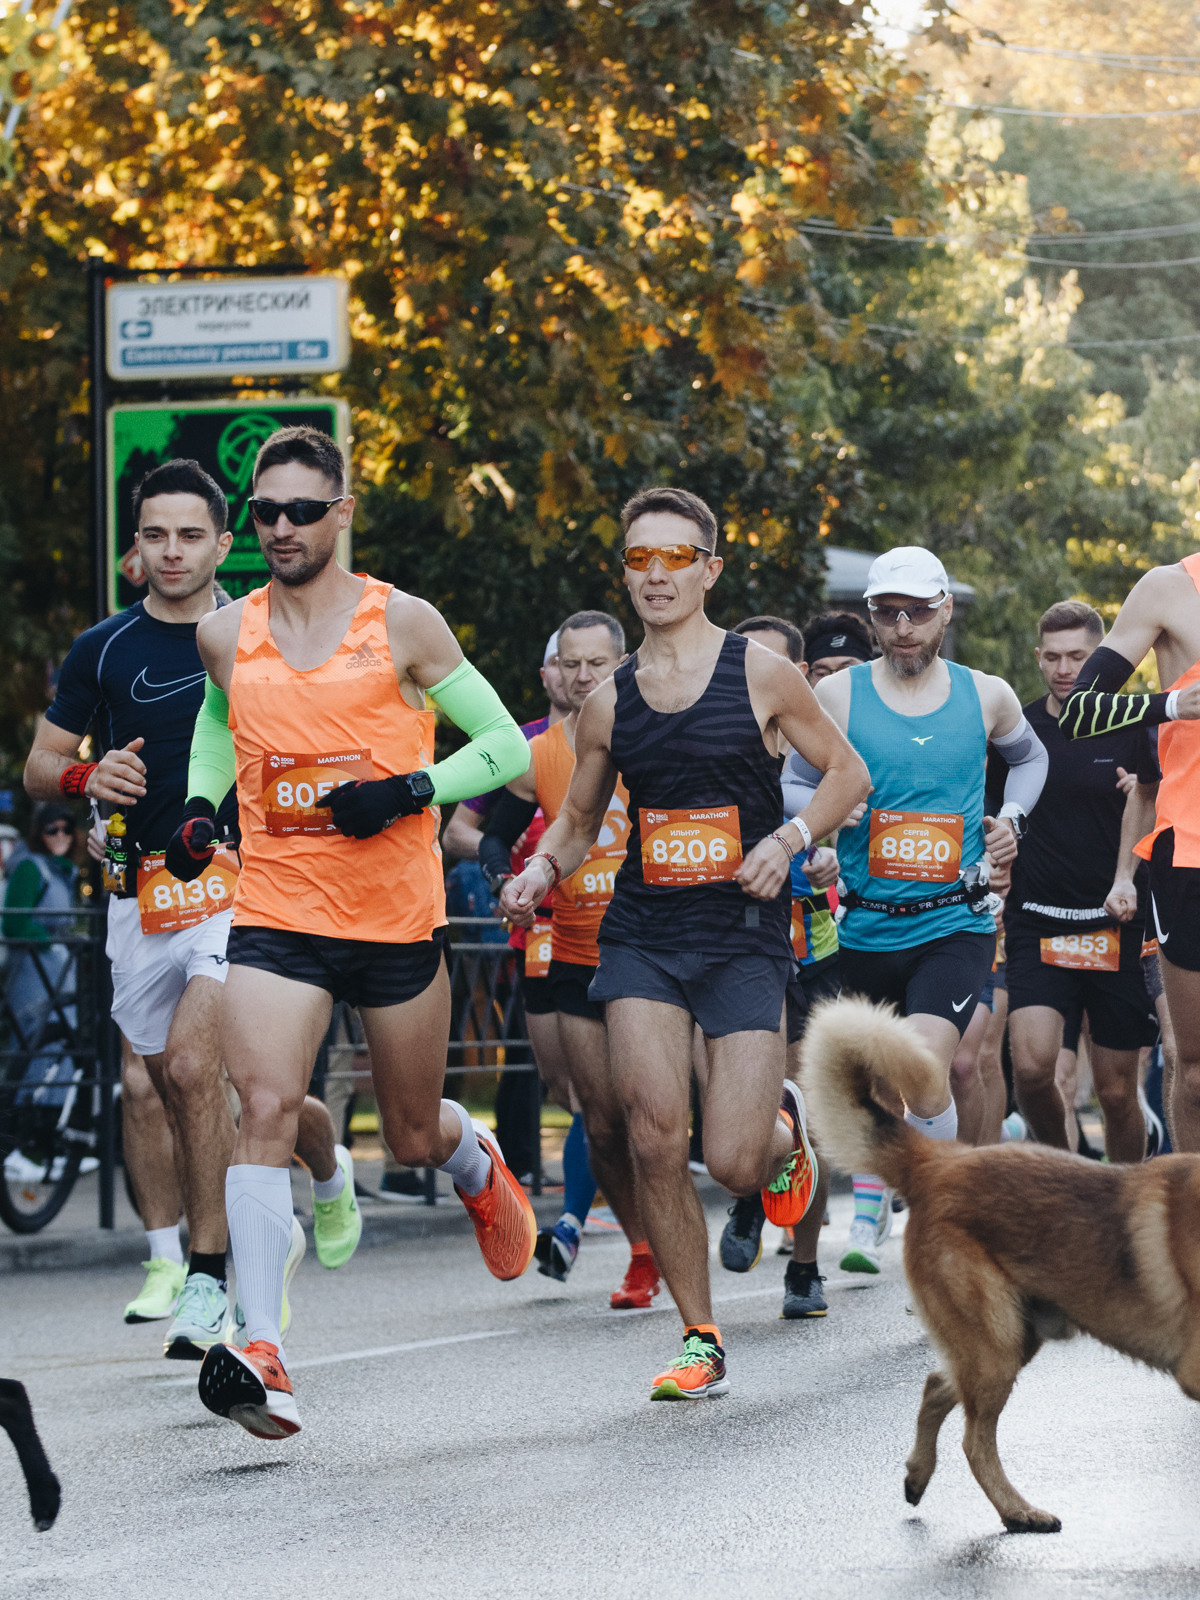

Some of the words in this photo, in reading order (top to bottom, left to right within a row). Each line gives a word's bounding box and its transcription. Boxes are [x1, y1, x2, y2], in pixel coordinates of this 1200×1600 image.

[138, 286, 311, 315] ЭЛЕКТРИЧЕСКИЙ
[345, 657, 382, 670] adidas
[317, 754, 361, 764] MARATHON
[276, 780, 355, 808] 805
[689, 811, 729, 820] MARATHON
[922, 816, 957, 824] MARATHON
[670, 829, 700, 837] ИЛЬНУР
[903, 829, 930, 837] СЕРГЕЙ
[652, 837, 728, 863] 8206
[881, 836, 951, 862] 8820
[153, 875, 226, 909] 8136
[583, 871, 614, 893] 911
[1022, 901, 1109, 921] #CONNEKTCHURC
[1051, 934, 1109, 954] 8353
